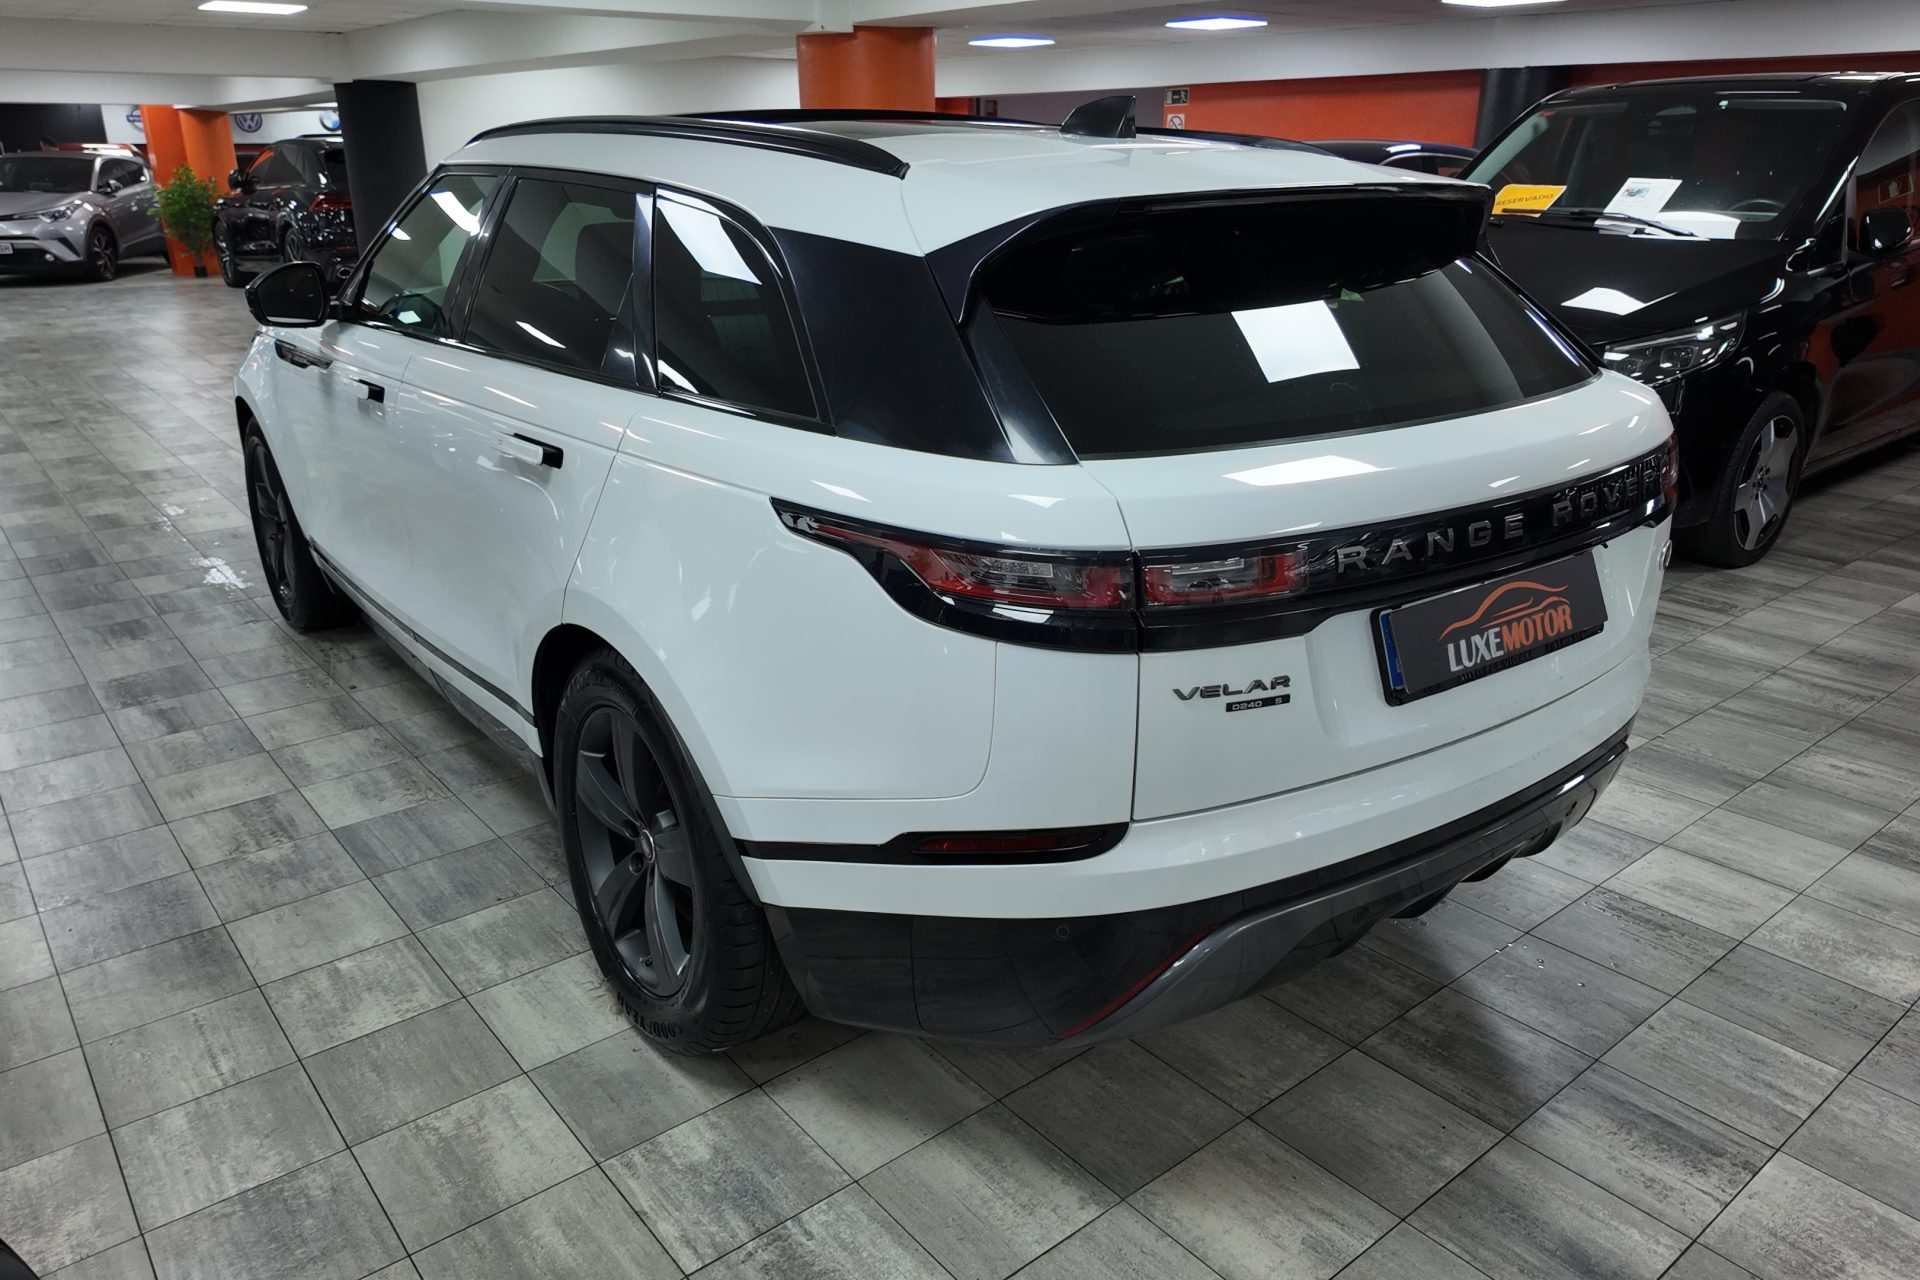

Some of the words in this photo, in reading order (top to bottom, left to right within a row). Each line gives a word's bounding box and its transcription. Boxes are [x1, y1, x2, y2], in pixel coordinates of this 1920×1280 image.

[1496, 193, 1554, 207] RESERVADO
[1337, 512, 1526, 575] RANGE
[1553, 469, 1657, 528] ROVER
[1447, 604, 1575, 674] LUXEMOTOR
[1172, 675, 1291, 701] VELAR
[1232, 702, 1262, 712] D240
[1274, 697, 1283, 706] S
